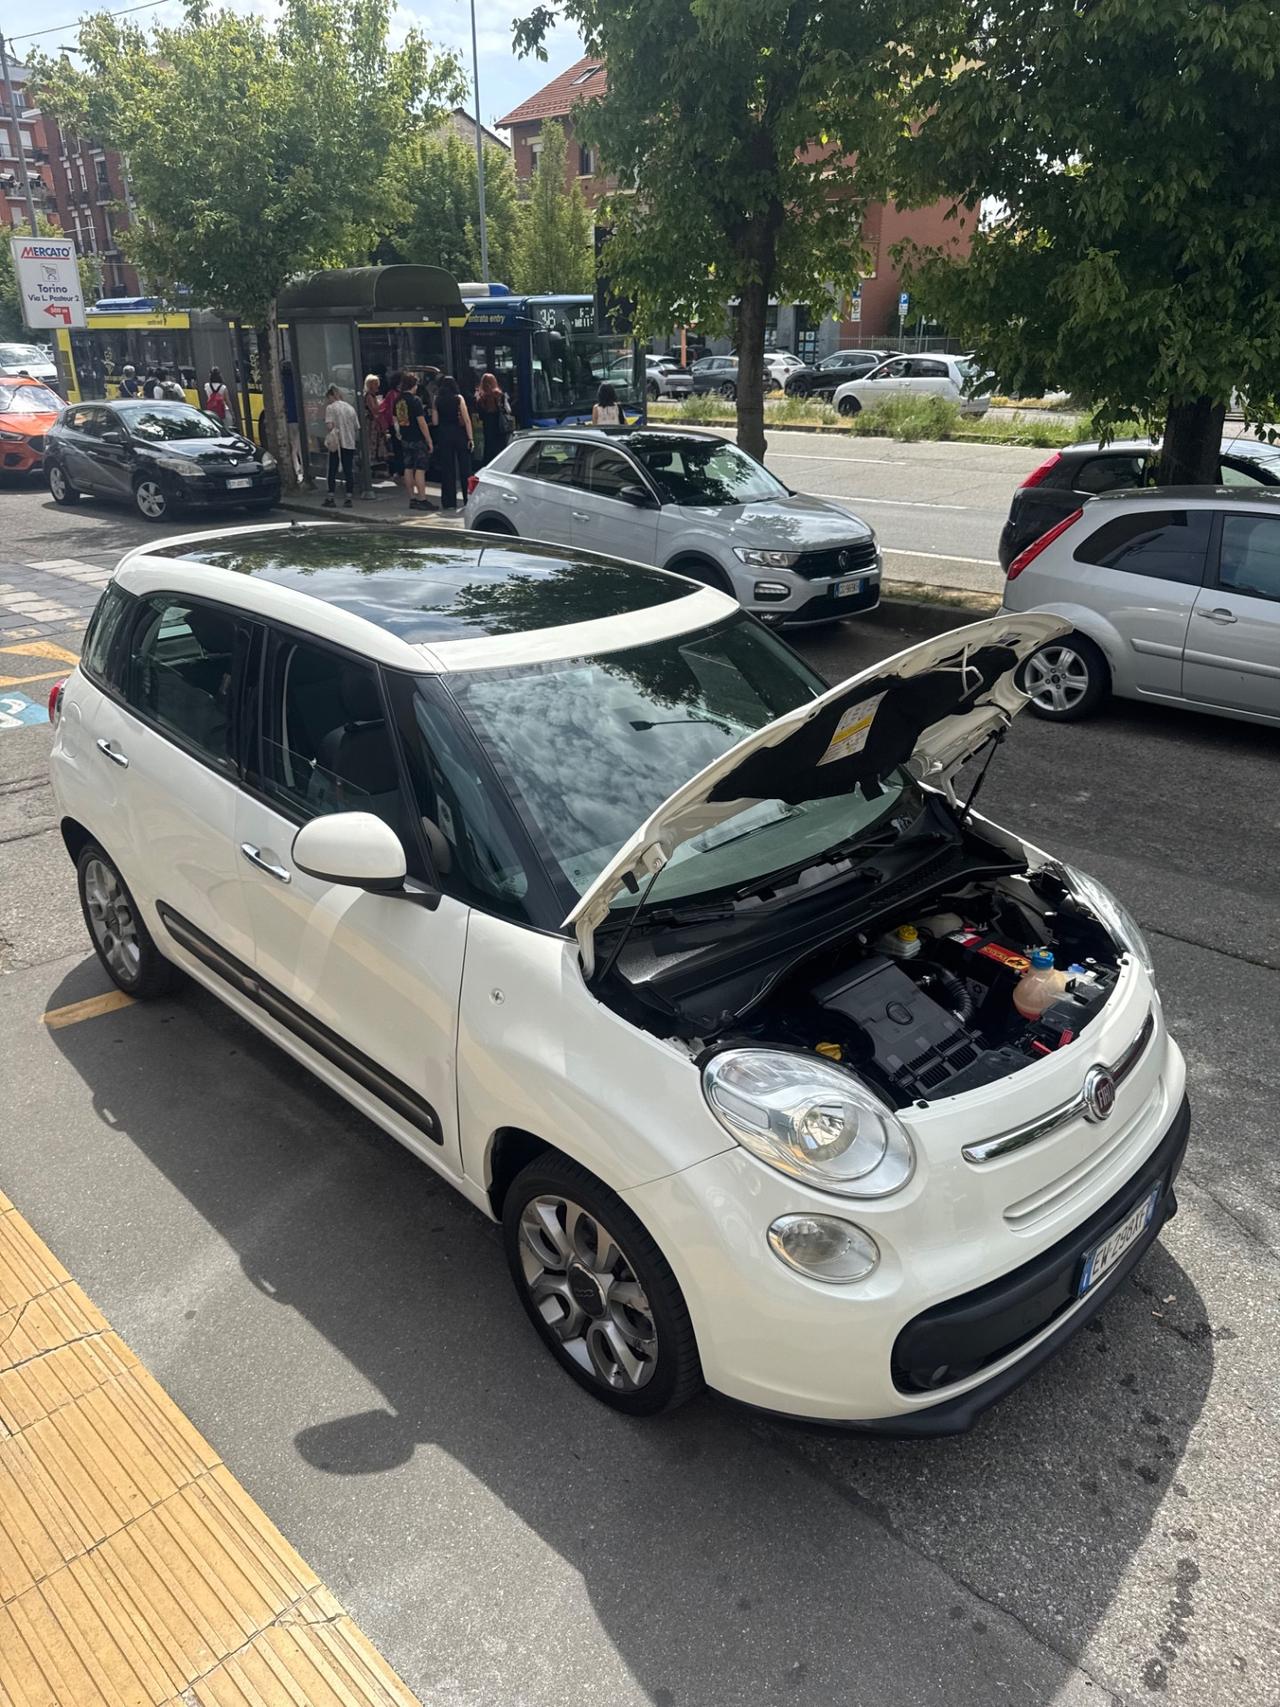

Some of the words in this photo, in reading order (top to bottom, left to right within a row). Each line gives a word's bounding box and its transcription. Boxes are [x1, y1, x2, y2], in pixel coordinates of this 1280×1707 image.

[37, 283, 68, 293] Torino
[489, 314, 505, 325] entry
[1097, 1082, 1112, 1109] FIAT
